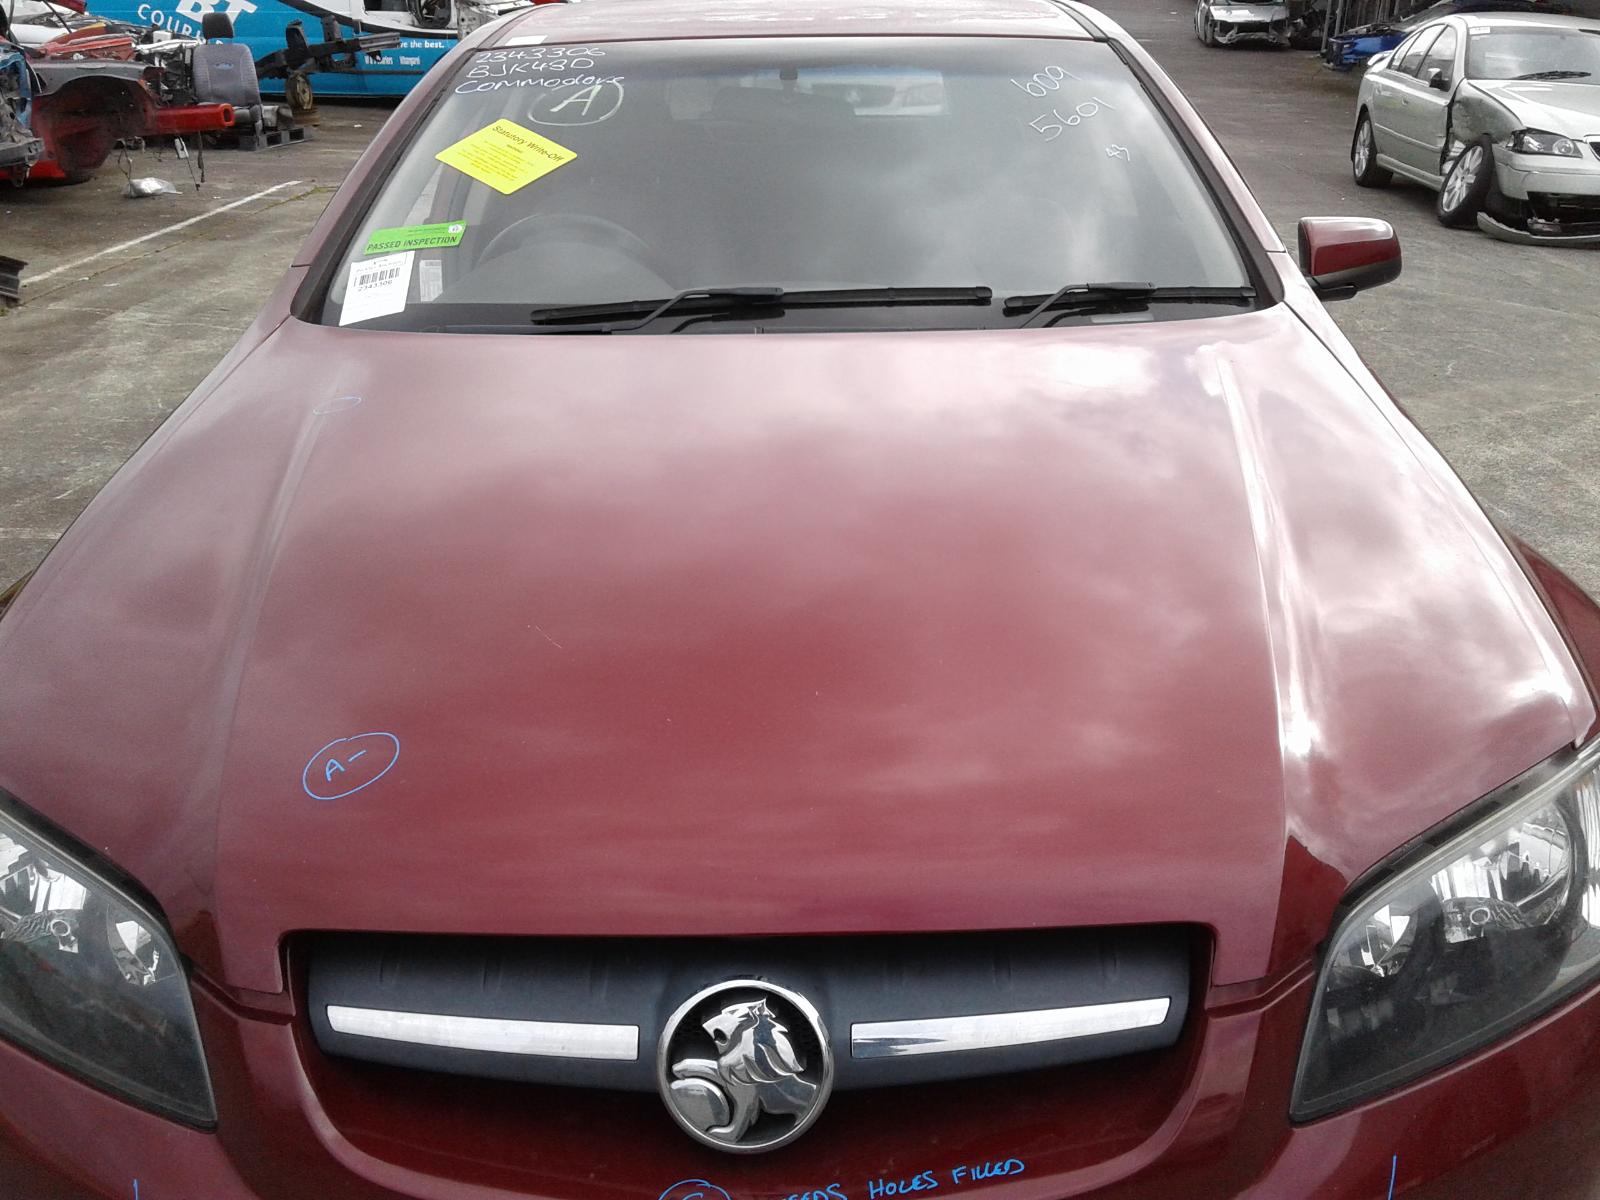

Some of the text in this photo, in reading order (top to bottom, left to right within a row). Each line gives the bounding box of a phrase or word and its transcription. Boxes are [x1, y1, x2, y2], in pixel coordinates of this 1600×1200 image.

[410, 40, 422, 48] the
[424, 40, 445, 49] best.
[476, 47, 606, 63] 2343306
[549, 84, 602, 117] A
[1029, 96, 1116, 141] 5601
[492, 125, 527, 145] Statutory
[527, 142, 565, 162] Write-Off
[367, 236, 457, 251] PASSED INSPECTION
[868, 1170, 939, 1200] HOLES
[951, 1159, 1025, 1184] FILLED
